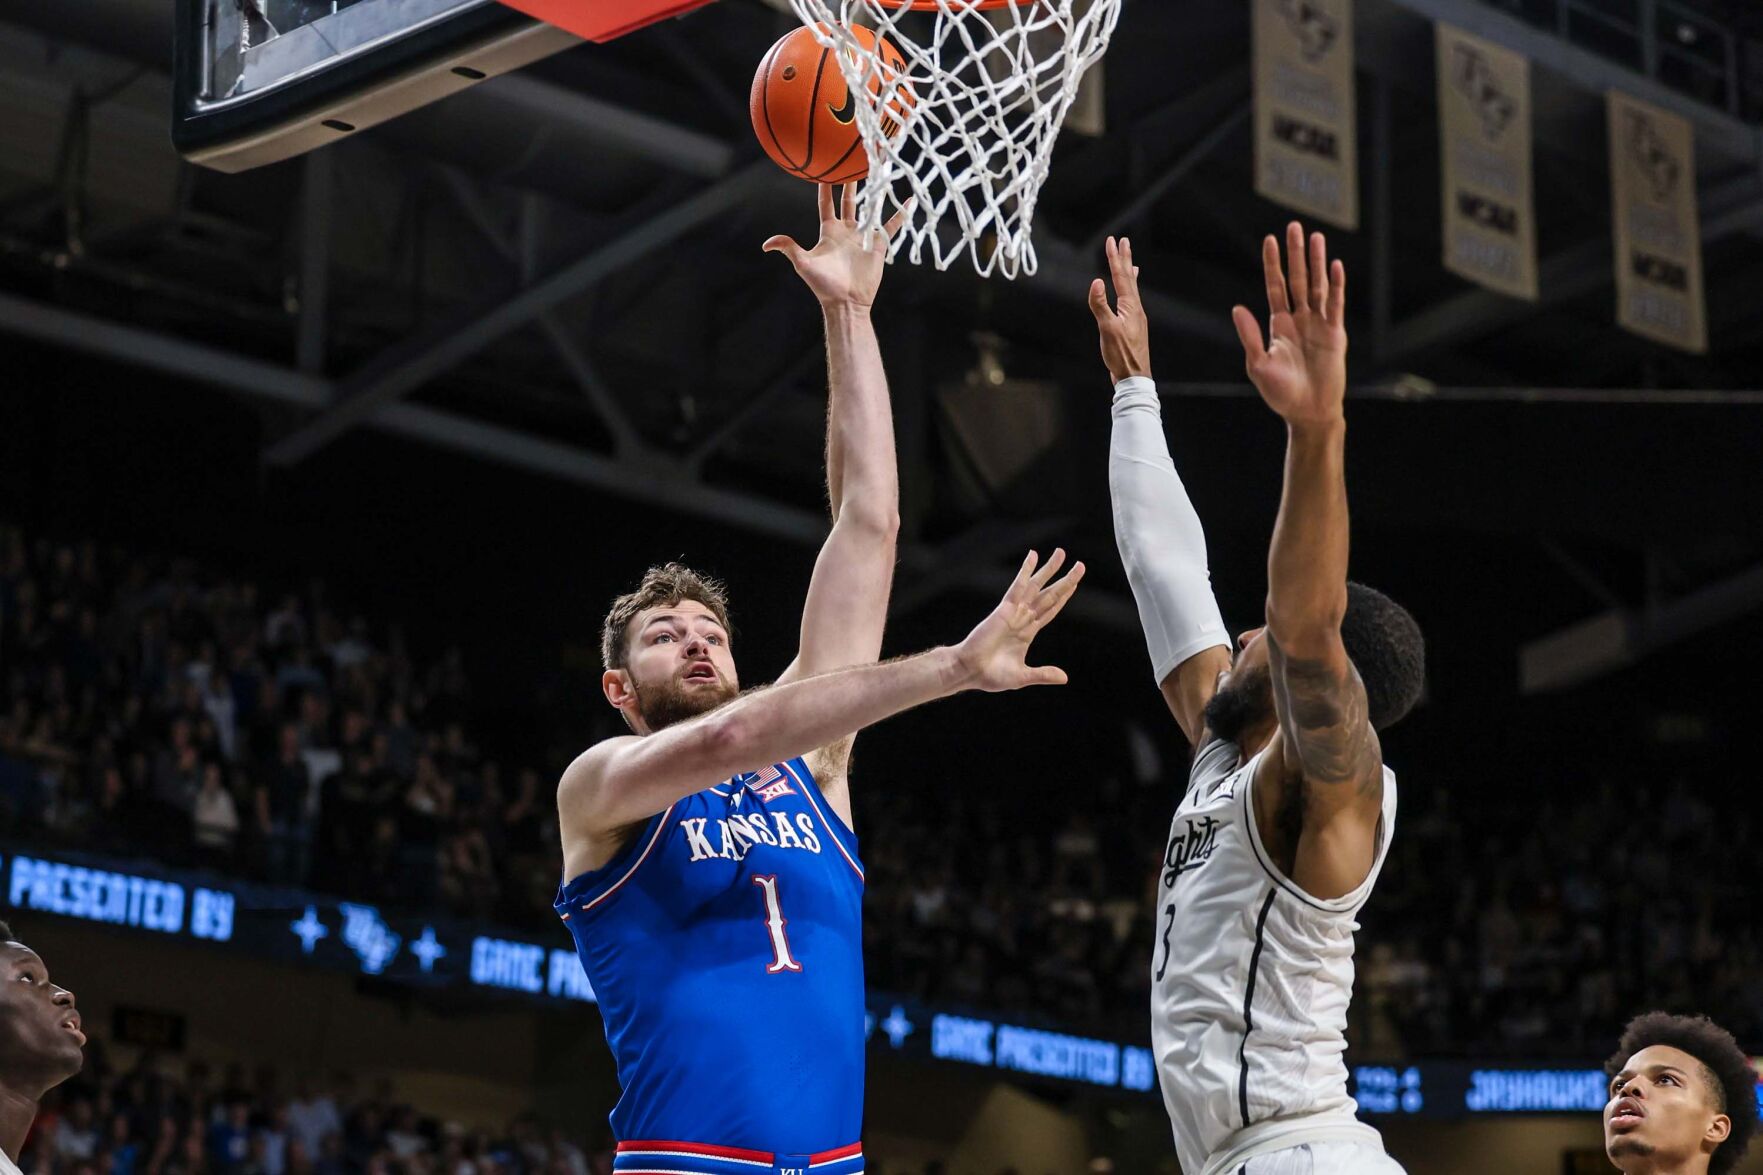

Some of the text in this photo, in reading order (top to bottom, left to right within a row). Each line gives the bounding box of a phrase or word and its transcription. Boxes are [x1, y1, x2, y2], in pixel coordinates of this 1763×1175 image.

[680, 810, 822, 862] KANSAS
[1164, 815, 1220, 888] ghts
[9, 855, 236, 943] PRESENTED BY
[752, 874, 803, 974] 1
[470, 936, 546, 994] GAME
[995, 1023, 1120, 1087] PRESENTED
